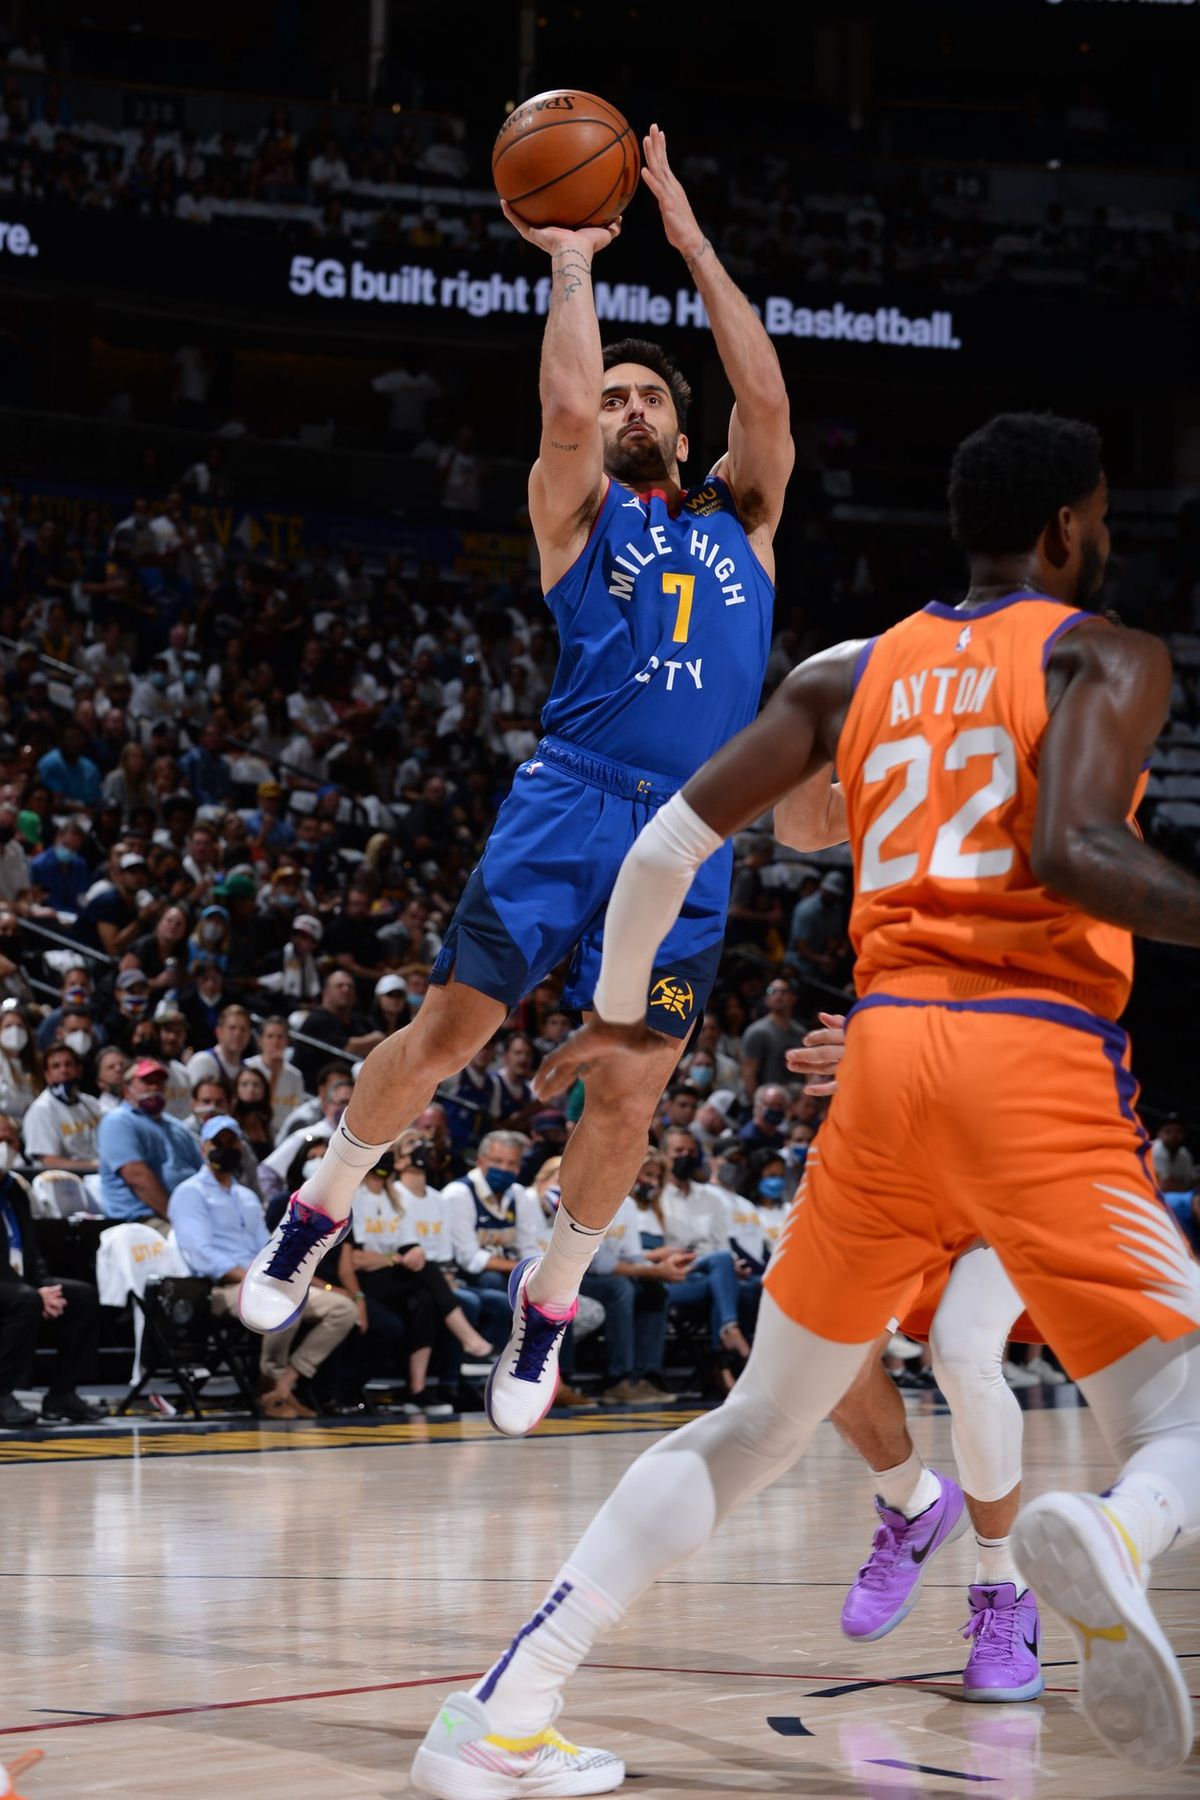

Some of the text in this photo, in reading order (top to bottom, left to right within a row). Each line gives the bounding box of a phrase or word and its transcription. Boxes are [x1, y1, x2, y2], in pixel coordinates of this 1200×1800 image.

[289, 255, 346, 298] 5G
[351, 260, 437, 306] built
[440, 269, 530, 317] right
[594, 281, 671, 325] Mile
[765, 296, 962, 350] Basketball.
[686, 486, 718, 509] WU
[608, 525, 673, 602] MILE
[690, 529, 746, 606] HIGH
[662, 572, 696, 644] 7
[635, 655, 703, 691] CTY
[890, 666, 997, 727] AYTON
[860, 725, 1018, 893] 22
